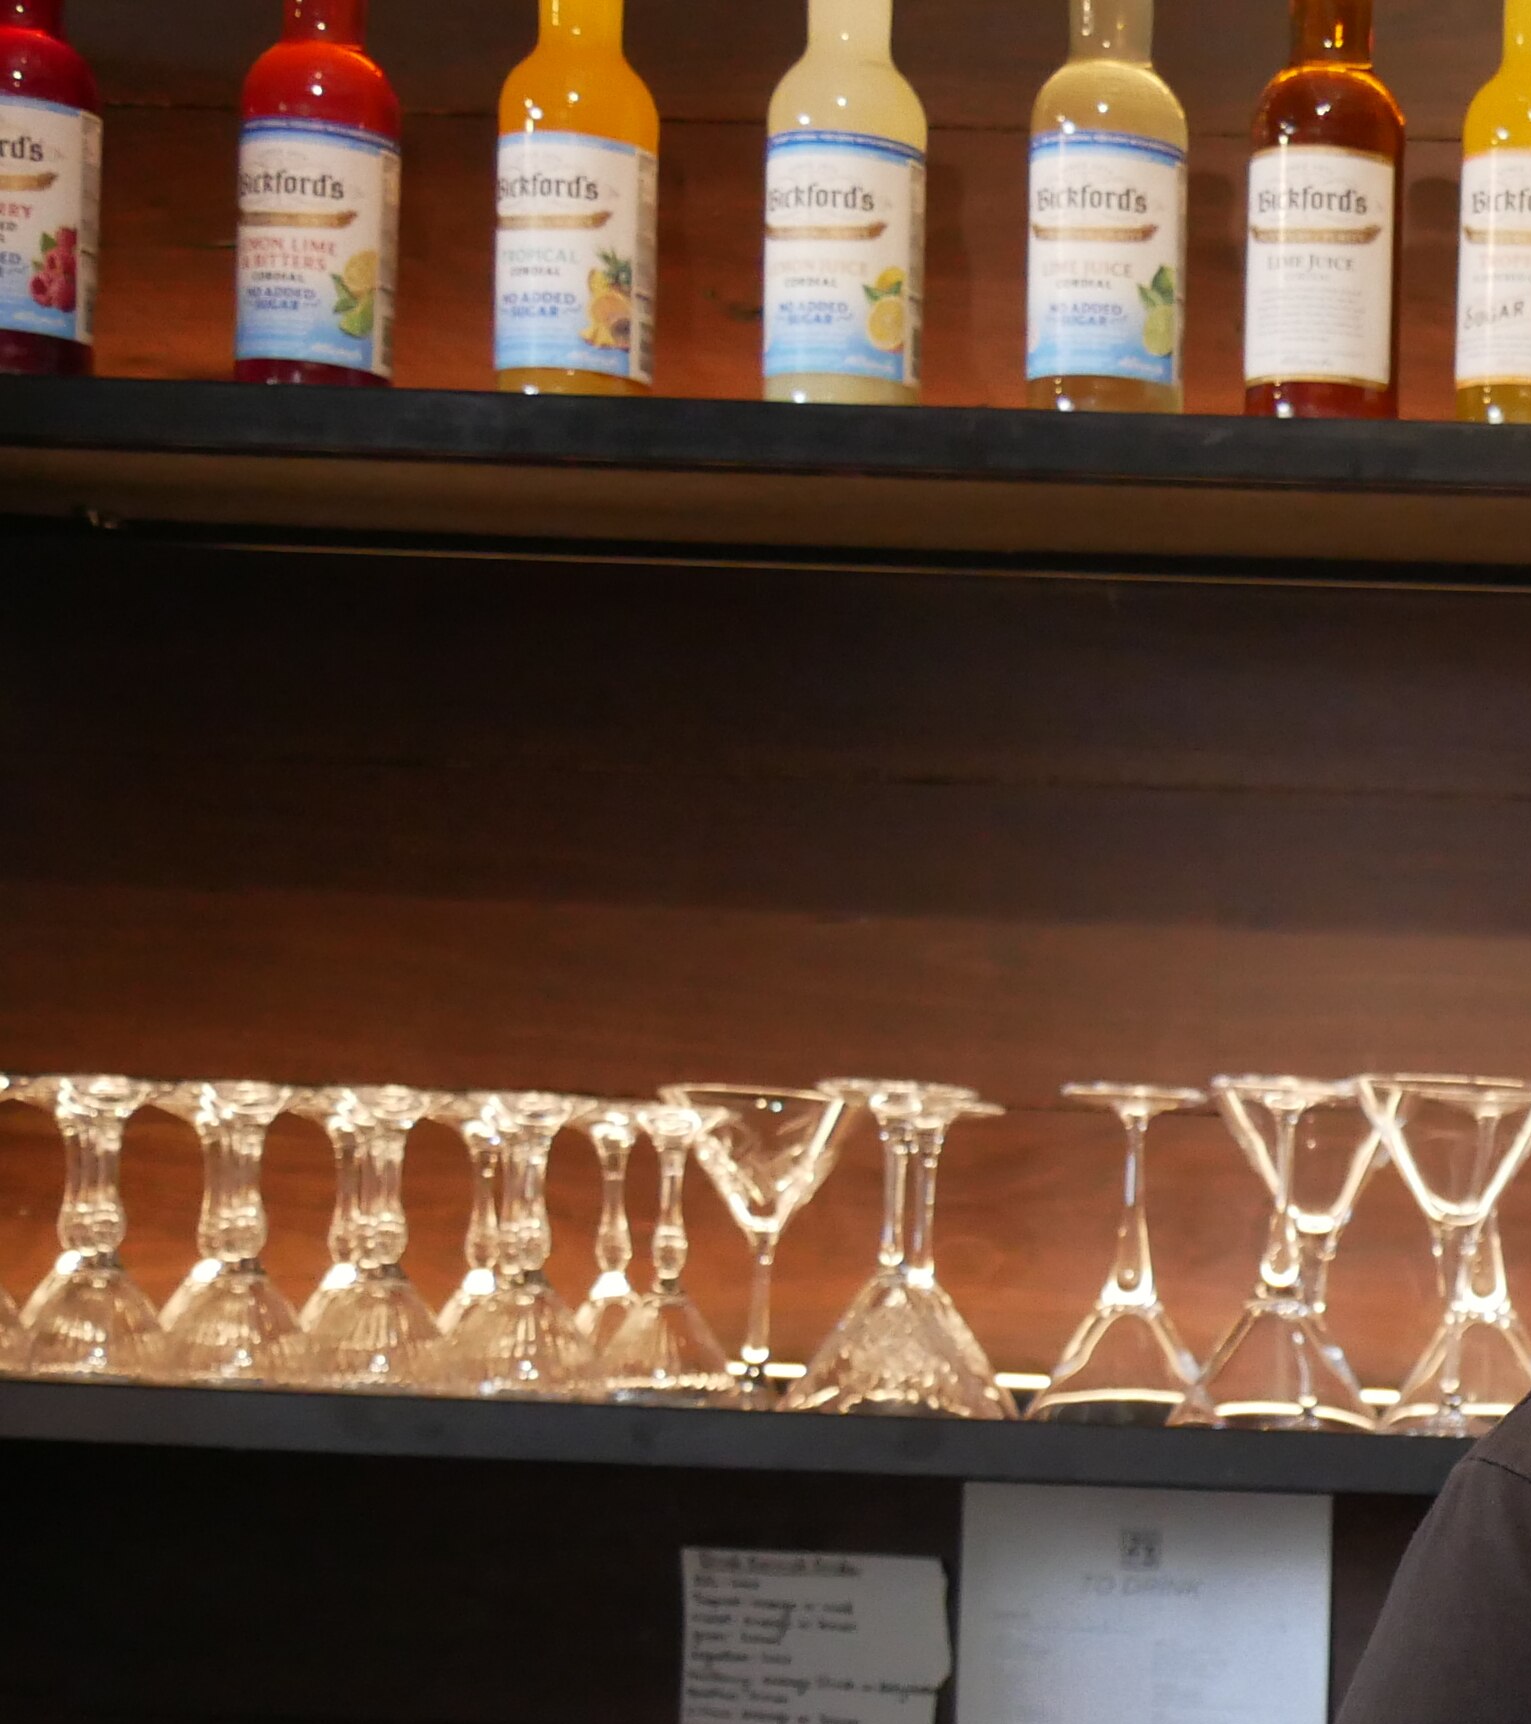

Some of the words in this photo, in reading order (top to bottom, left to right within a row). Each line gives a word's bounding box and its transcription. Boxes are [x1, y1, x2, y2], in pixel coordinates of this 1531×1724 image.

[1037, 184, 1148, 214] Bickford's
[1258, 185, 1368, 215] Bickford's
[1083, 261, 1132, 278] JUICE
[1308, 254, 1356, 272] JUICE
[521, 292, 576, 304] ADDED
[795, 301, 849, 314] ADDED
[1071, 302, 1123, 316] ADDED
